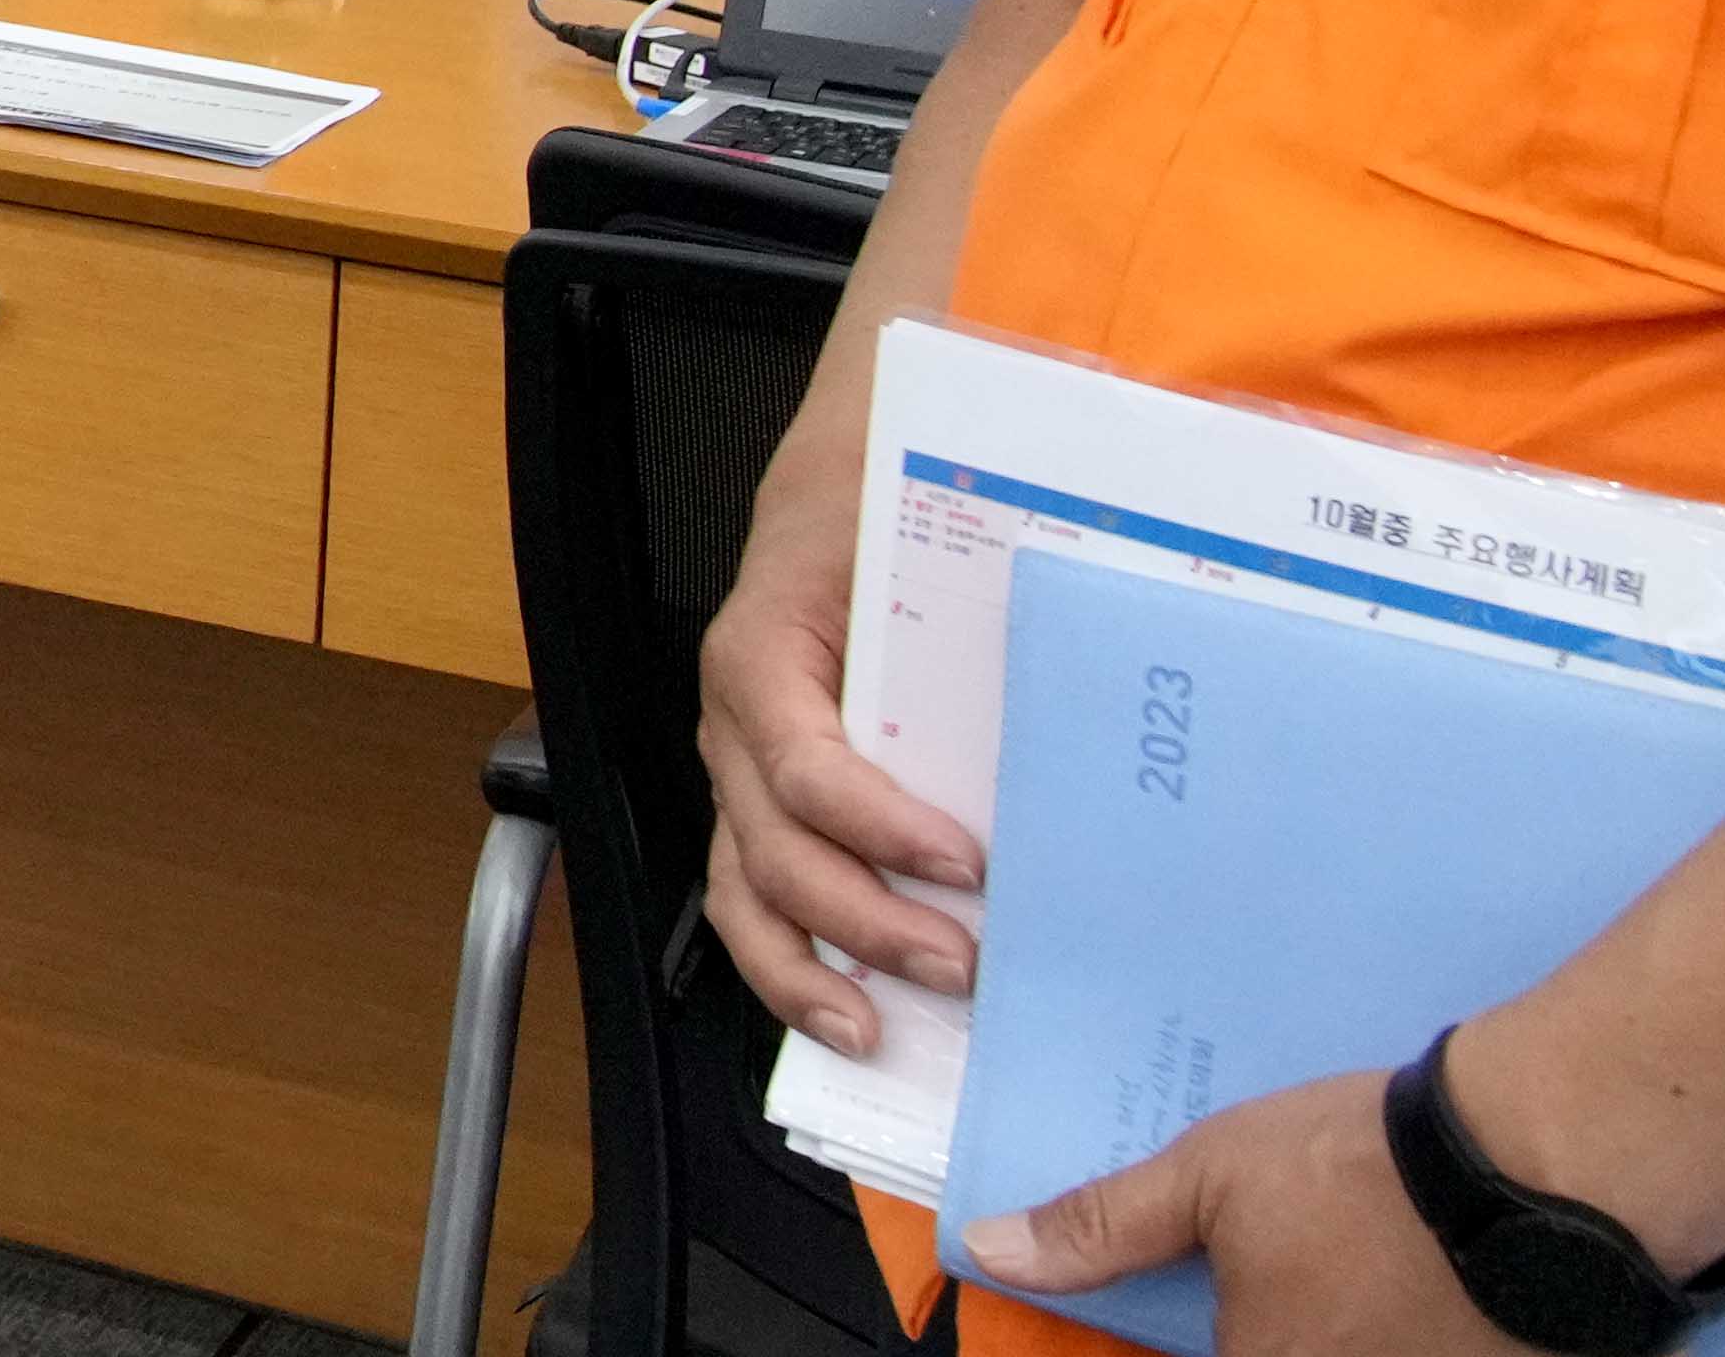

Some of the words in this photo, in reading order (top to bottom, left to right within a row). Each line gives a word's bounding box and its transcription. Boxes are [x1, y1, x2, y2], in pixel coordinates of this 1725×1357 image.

[1306, 494, 1413, 549] 10월중
[1432, 523, 1648, 608] 주요행사계획
[1136, 662, 1195, 802] 2023
